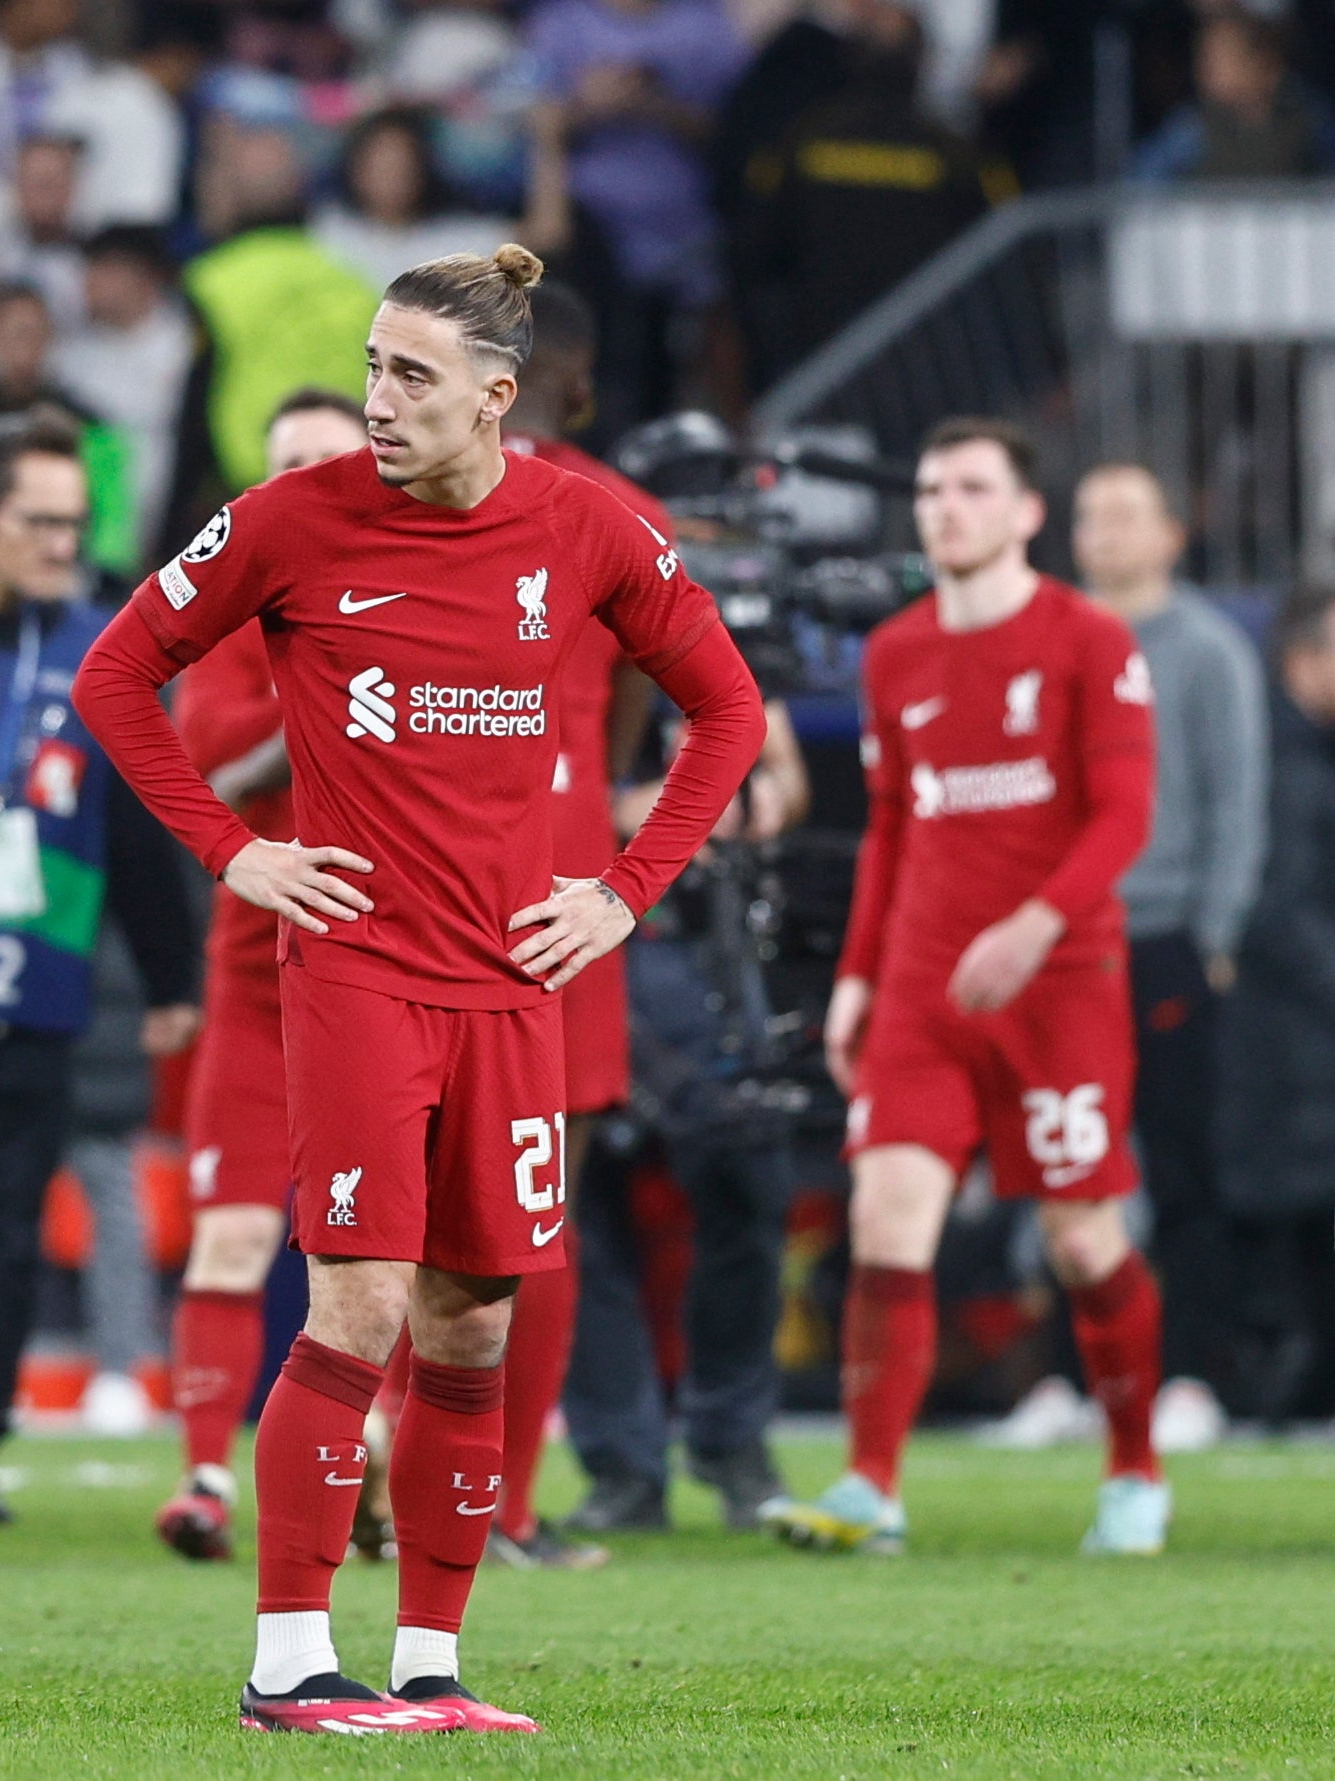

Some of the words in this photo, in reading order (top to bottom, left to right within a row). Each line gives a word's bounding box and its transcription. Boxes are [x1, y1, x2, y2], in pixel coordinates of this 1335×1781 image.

[409, 681, 543, 711] standard
[409, 707, 546, 737] chartered
[1021, 1082, 1111, 1166] 26
[510, 1111, 564, 1213] 21
